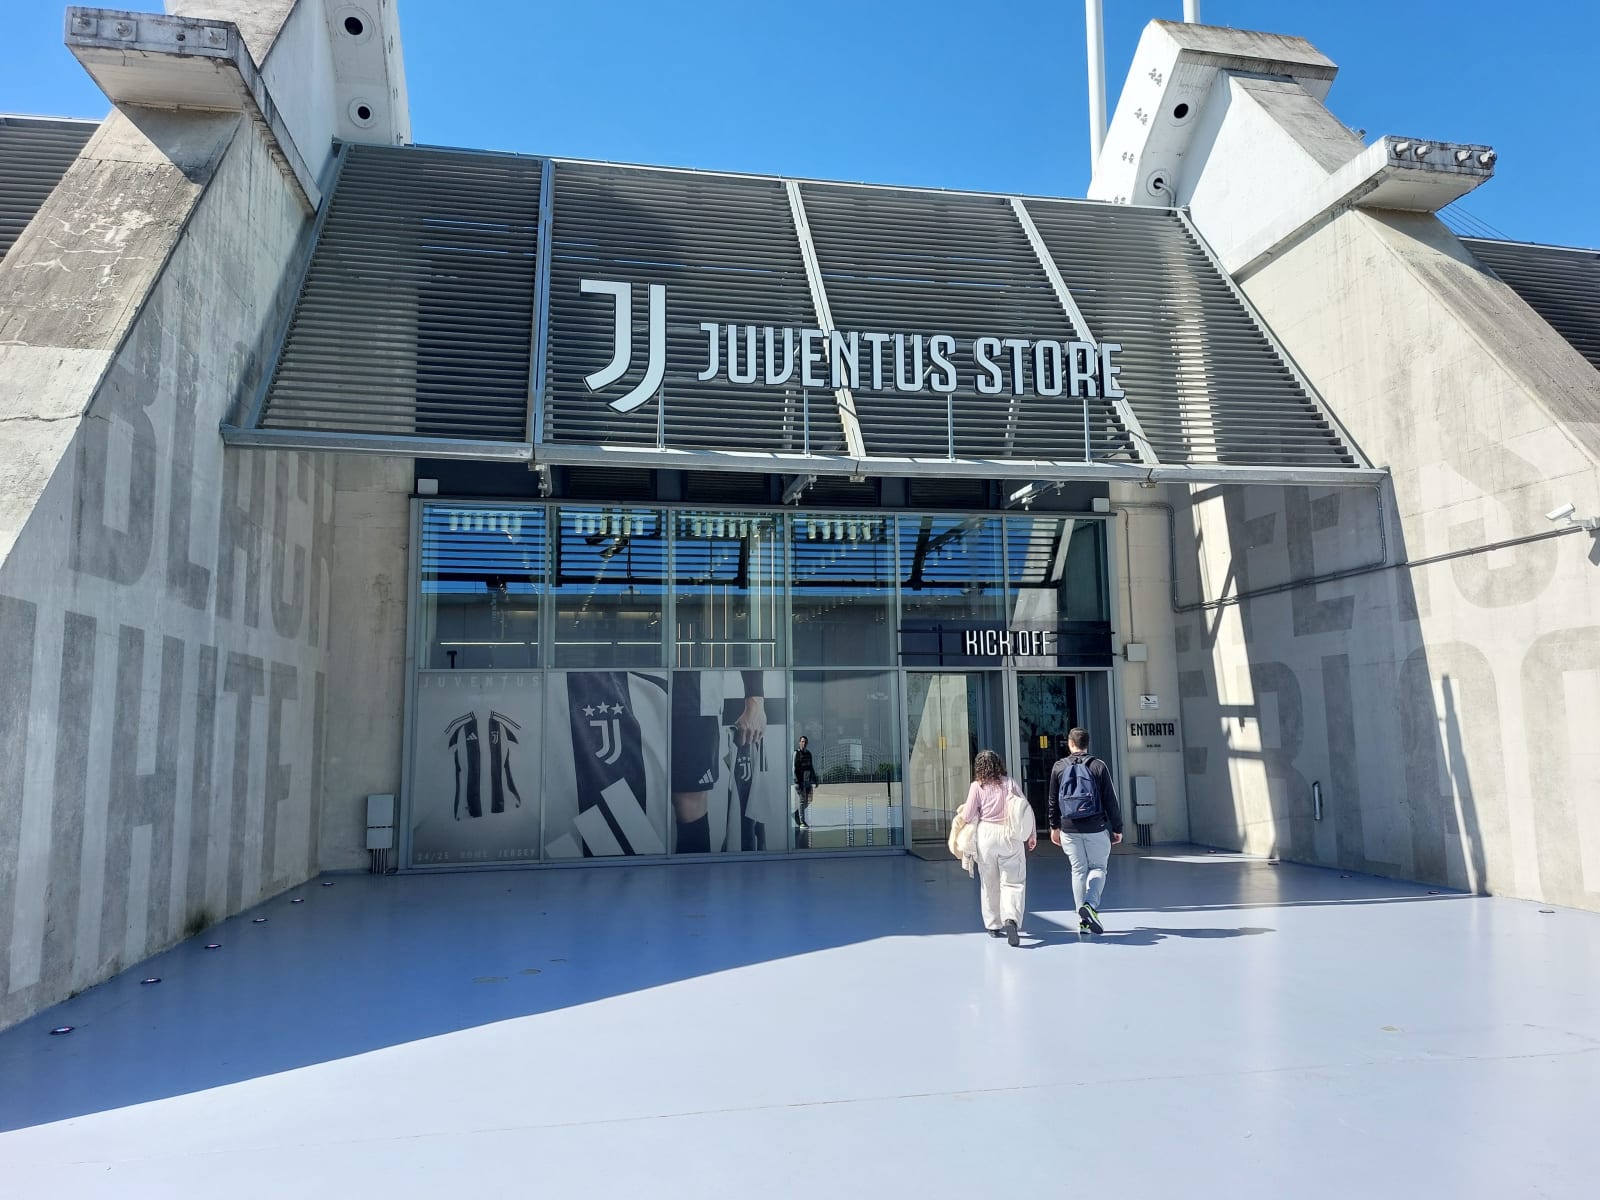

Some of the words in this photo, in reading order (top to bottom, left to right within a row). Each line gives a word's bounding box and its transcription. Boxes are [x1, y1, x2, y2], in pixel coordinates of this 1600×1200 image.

[698, 322, 958, 394] JUVENTUS
[972, 336, 1127, 400] STORE
[965, 629, 1011, 656] KICK
[1018, 629, 1051, 656] OFF
[423, 674, 540, 689] JUVENTUS
[1130, 722, 1175, 737] ENTRATA
